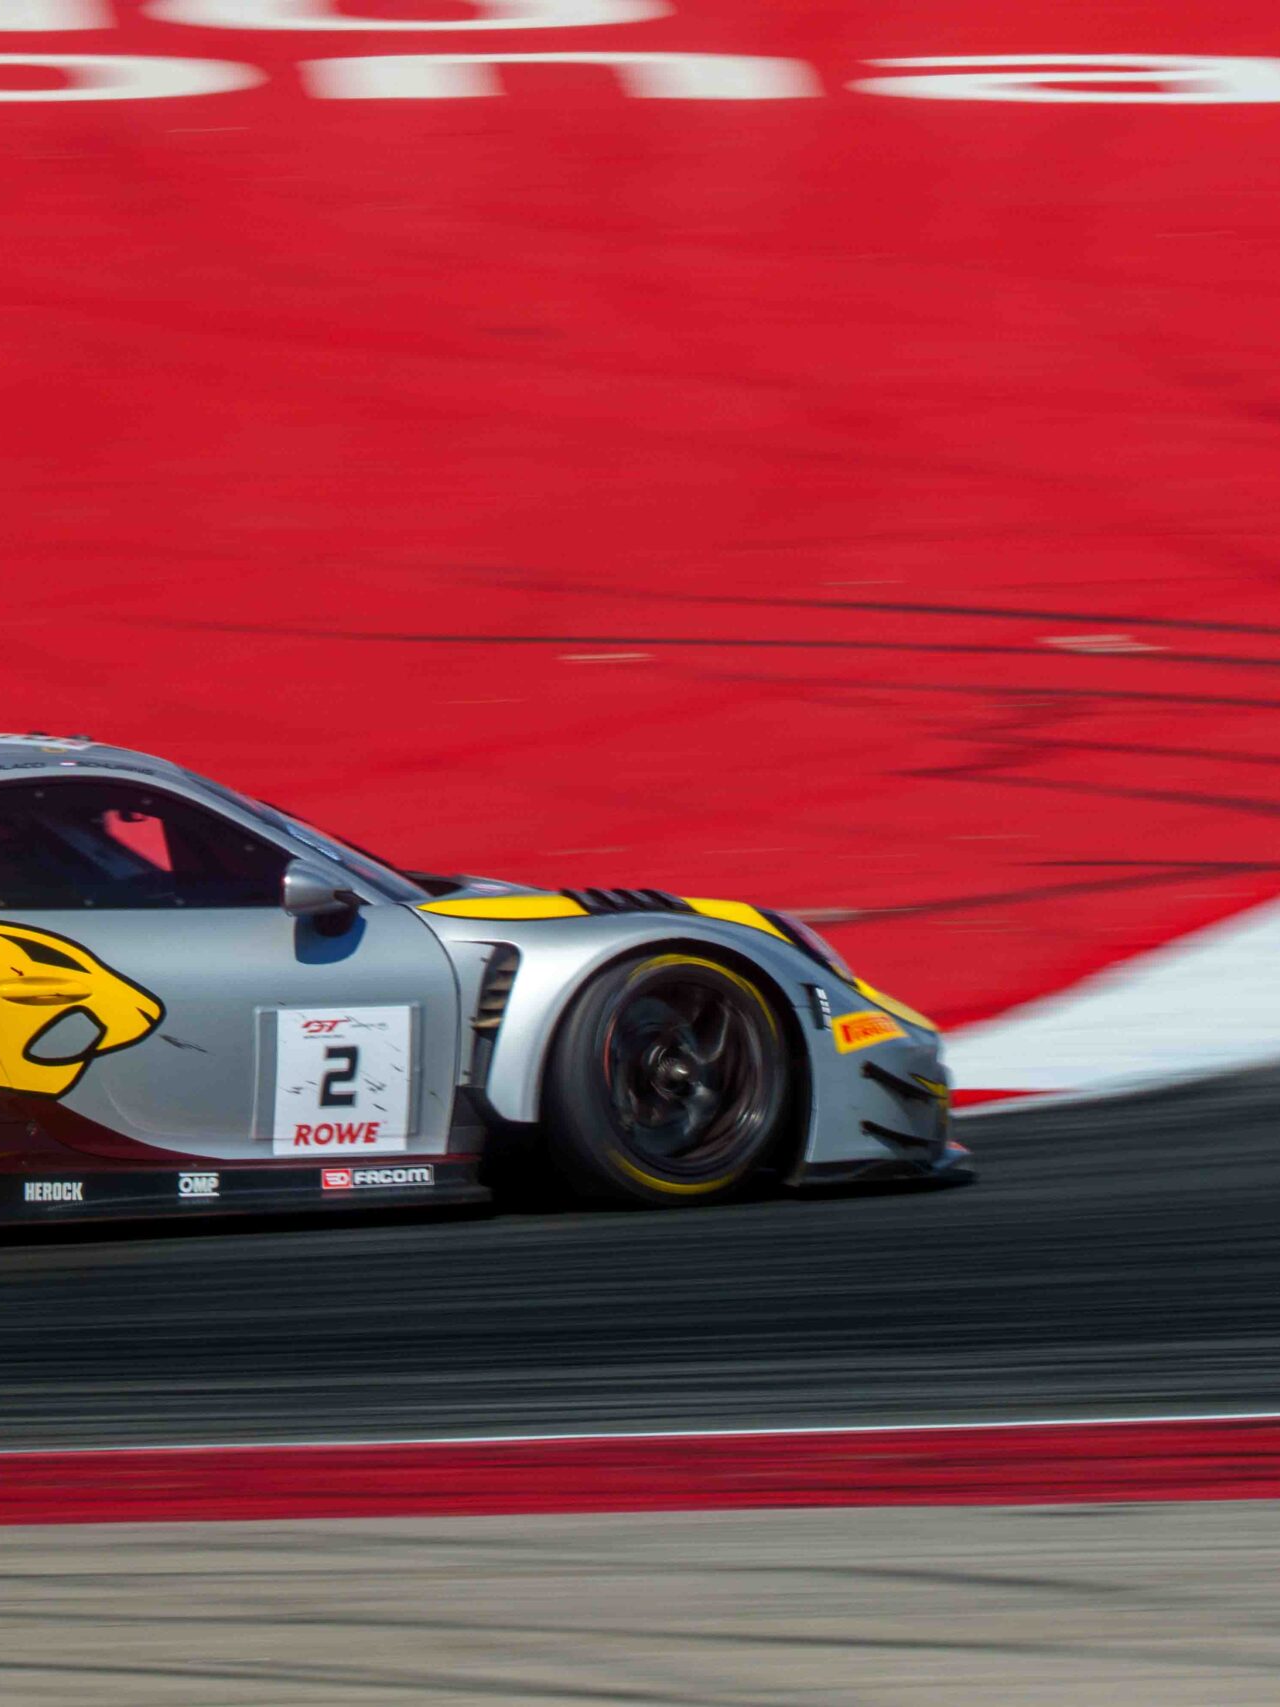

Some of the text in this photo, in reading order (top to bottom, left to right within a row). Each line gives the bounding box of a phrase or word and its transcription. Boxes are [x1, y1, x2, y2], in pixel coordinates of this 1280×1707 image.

[318, 1045, 359, 1108] 2
[293, 1121, 381, 1147] ROWE
[24, 1181, 83, 1202] HEROCK
[178, 1175, 219, 1194] OMP
